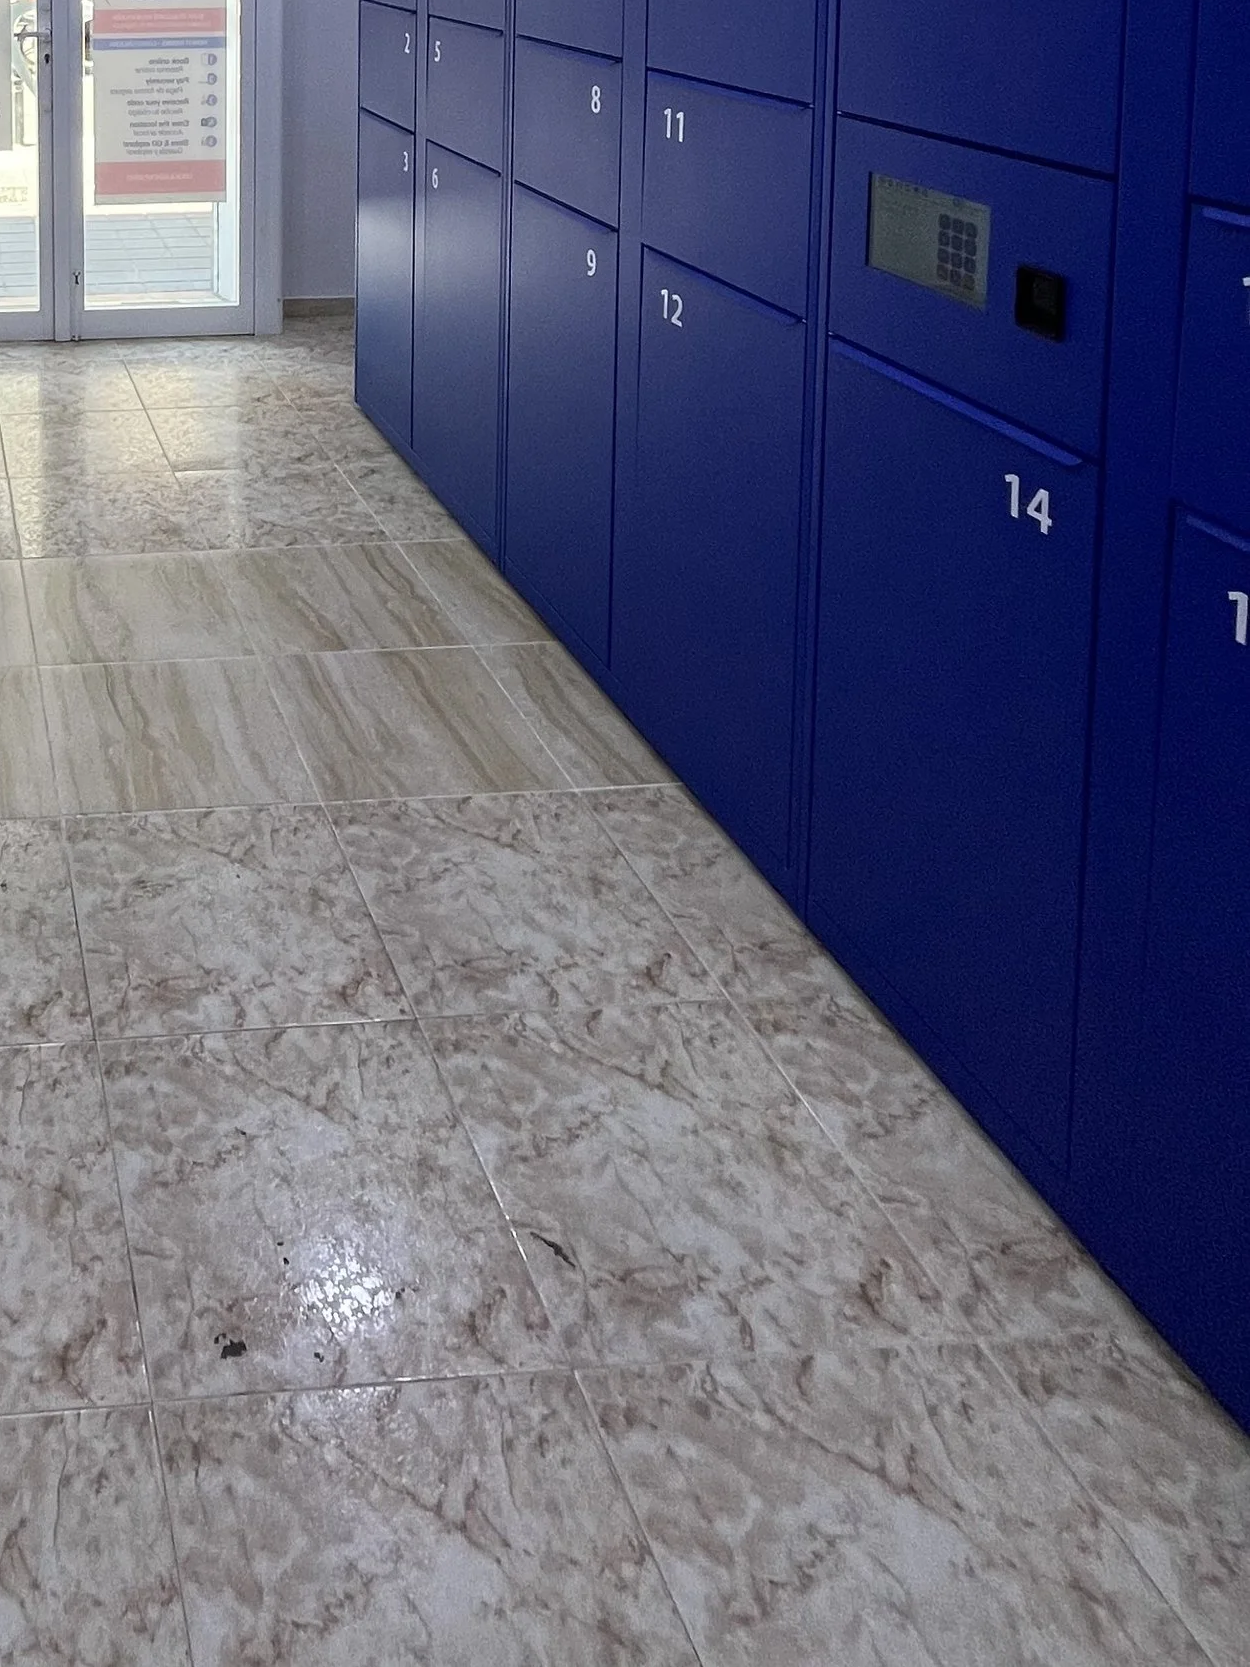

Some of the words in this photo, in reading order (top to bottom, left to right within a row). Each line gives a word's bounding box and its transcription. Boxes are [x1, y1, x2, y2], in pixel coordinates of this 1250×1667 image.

[403, 32, 411, 54] 2
[433, 40, 442, 62] 5
[590, 85, 602, 114] 8
[663, 108, 684, 143] 11
[402, 151, 410, 172] 3
[430, 167, 440, 189] 6
[585, 249, 598, 277] 9
[660, 288, 683, 327] 12
[1004, 473, 1053, 535] 14
[1227, 591, 1249, 646] 1
